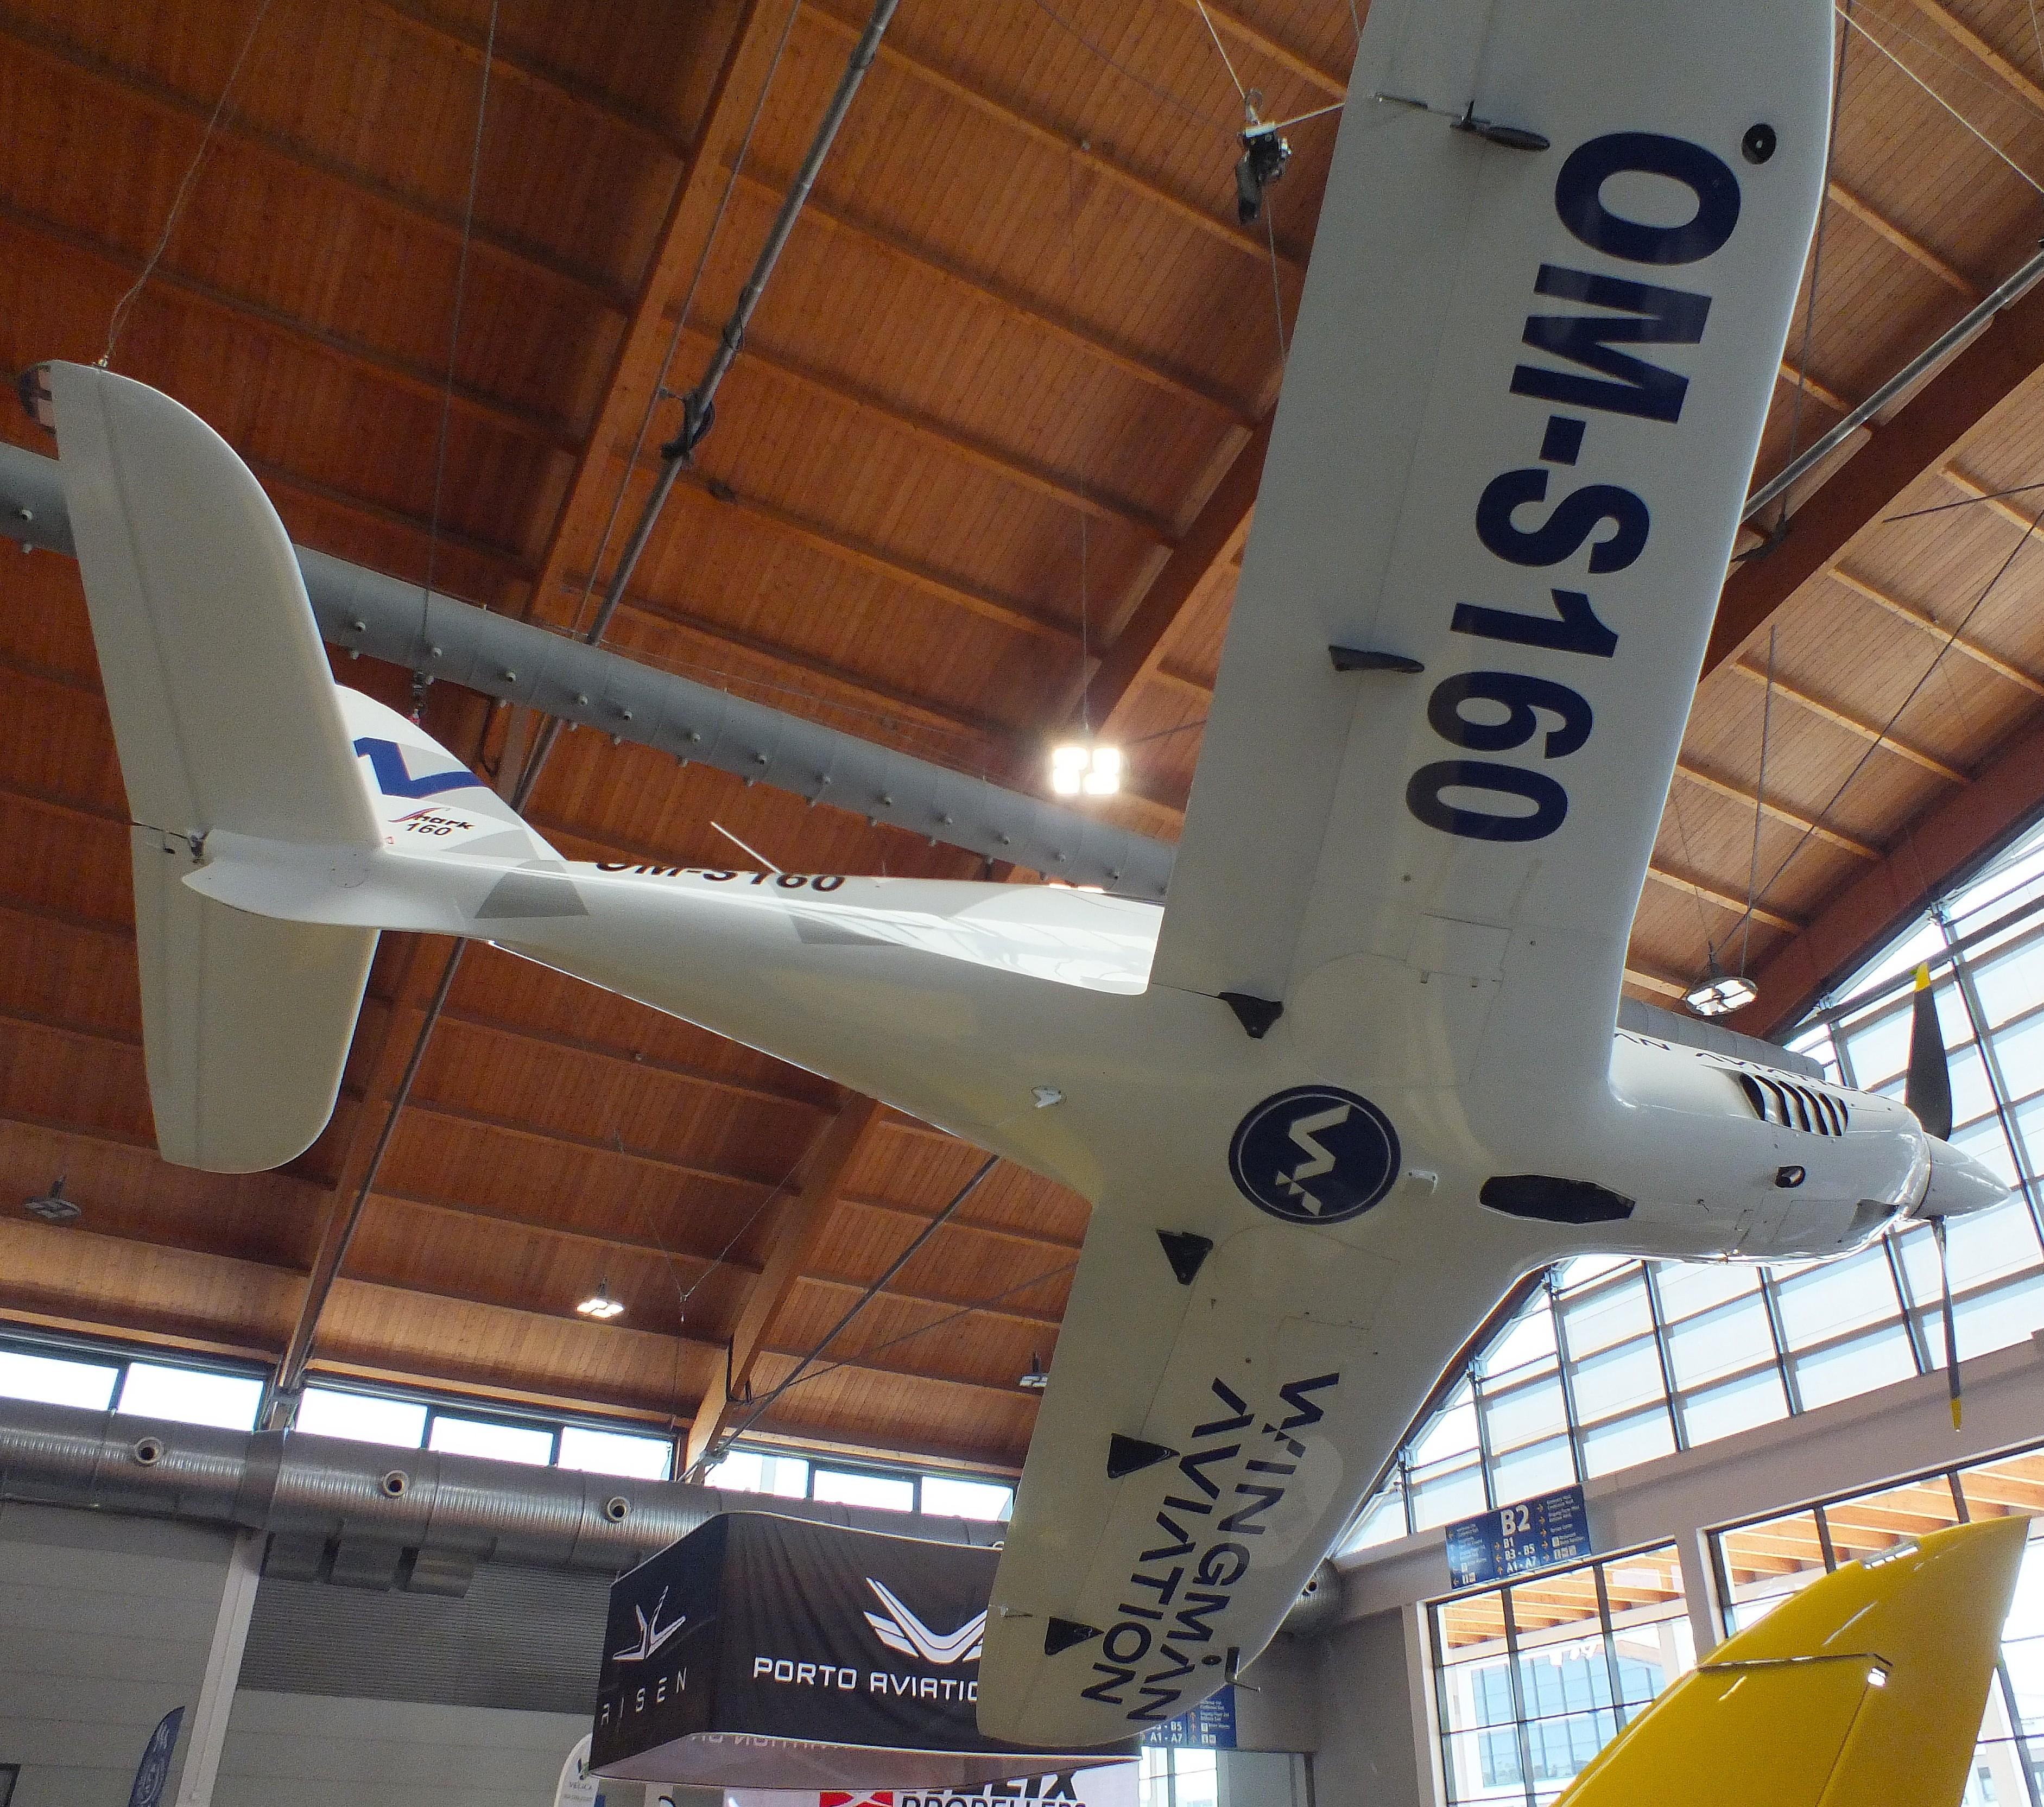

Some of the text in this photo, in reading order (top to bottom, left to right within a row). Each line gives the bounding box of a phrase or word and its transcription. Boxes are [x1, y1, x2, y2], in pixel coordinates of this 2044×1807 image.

[1406, 131, 1741, 841] OM-S160
[406, 823, 452, 836] 160
[1081, 1377, 1254, 1704] AVIATION
[1501, 1505, 1531, 1536] B2
[1127, 1373, 1339, 1720] WINGMAN
[753, 1656, 857, 1690] PORTO
[601, 1667, 687, 1726] RISEN
[1150, 1732, 1162, 1742] A1
[1171, 1732, 1182, 1742] A7
